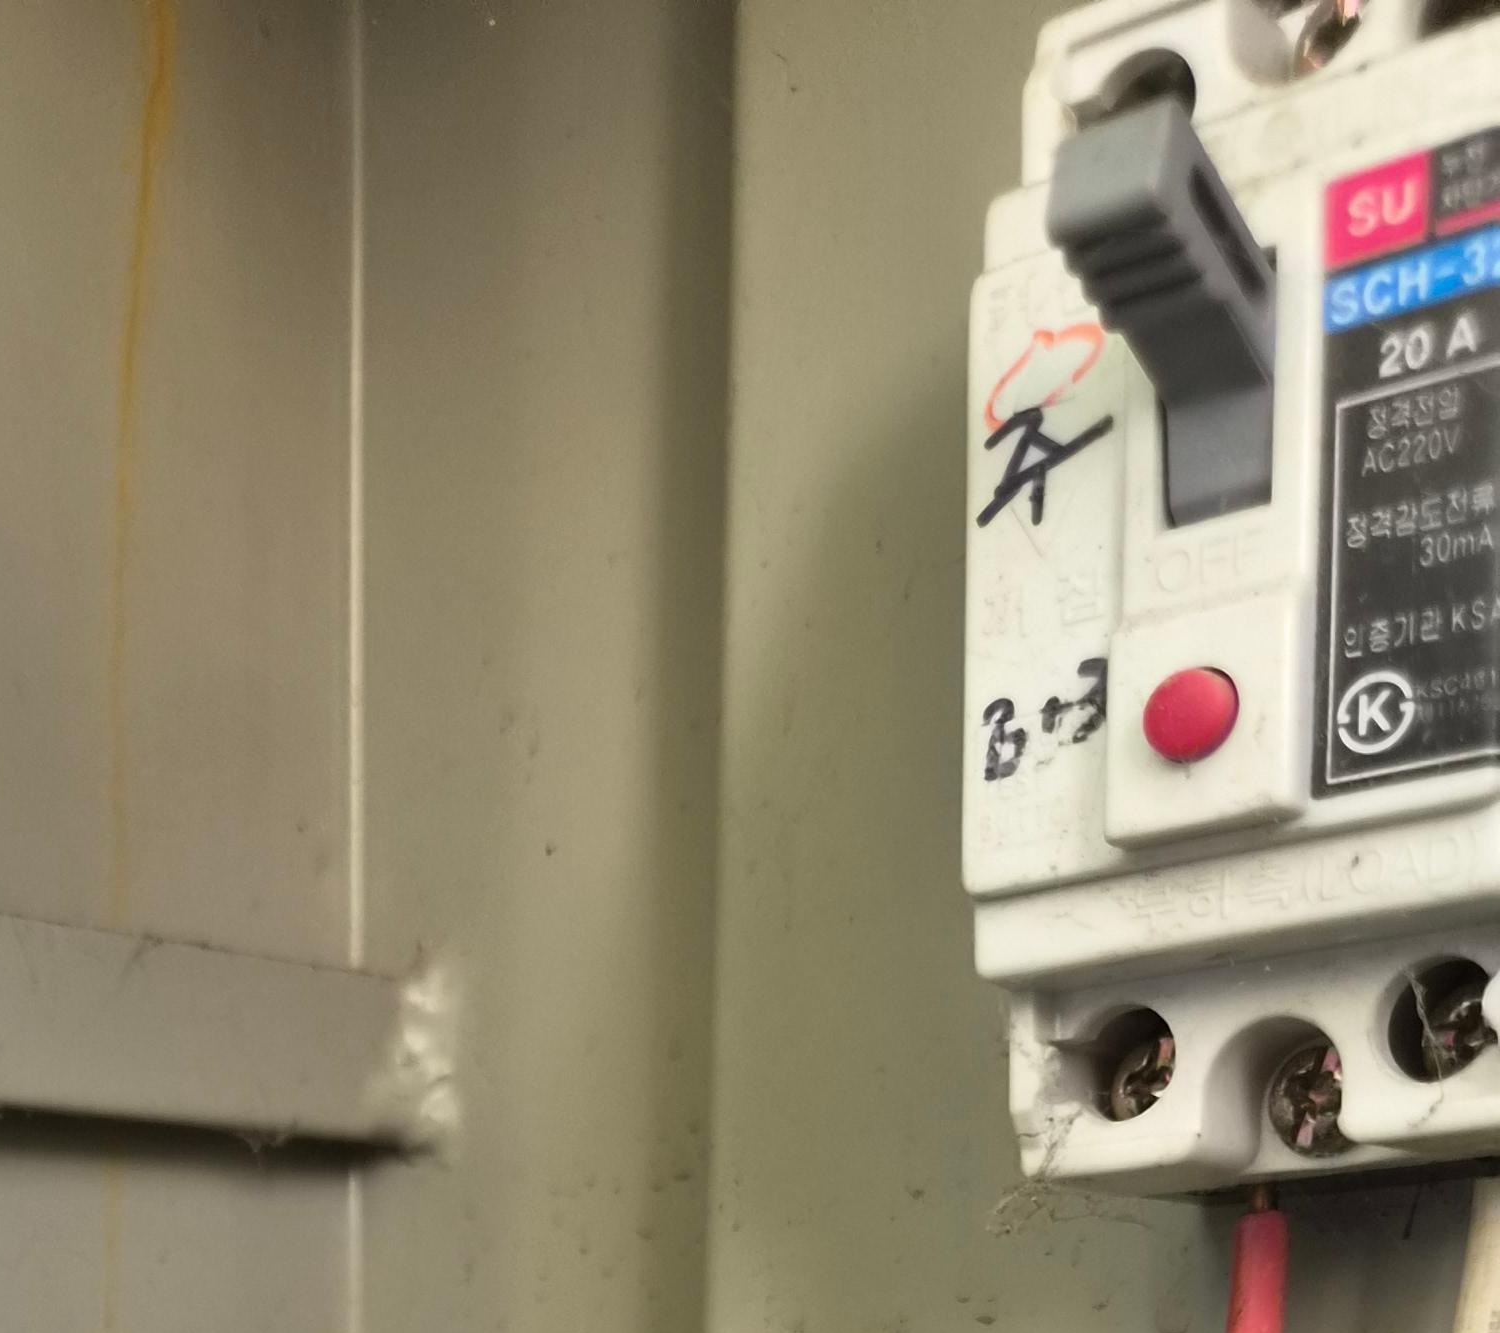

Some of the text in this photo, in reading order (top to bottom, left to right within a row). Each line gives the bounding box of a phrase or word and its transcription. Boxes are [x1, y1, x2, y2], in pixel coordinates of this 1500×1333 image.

[1347, 178, 1417, 238] SU
[1378, 314, 1478, 379] 20 A
[1367, 384, 1461, 440] 정격전압
[1361, 425, 1460, 478] AC220V
[1419, 524, 1493, 567] 30mA
